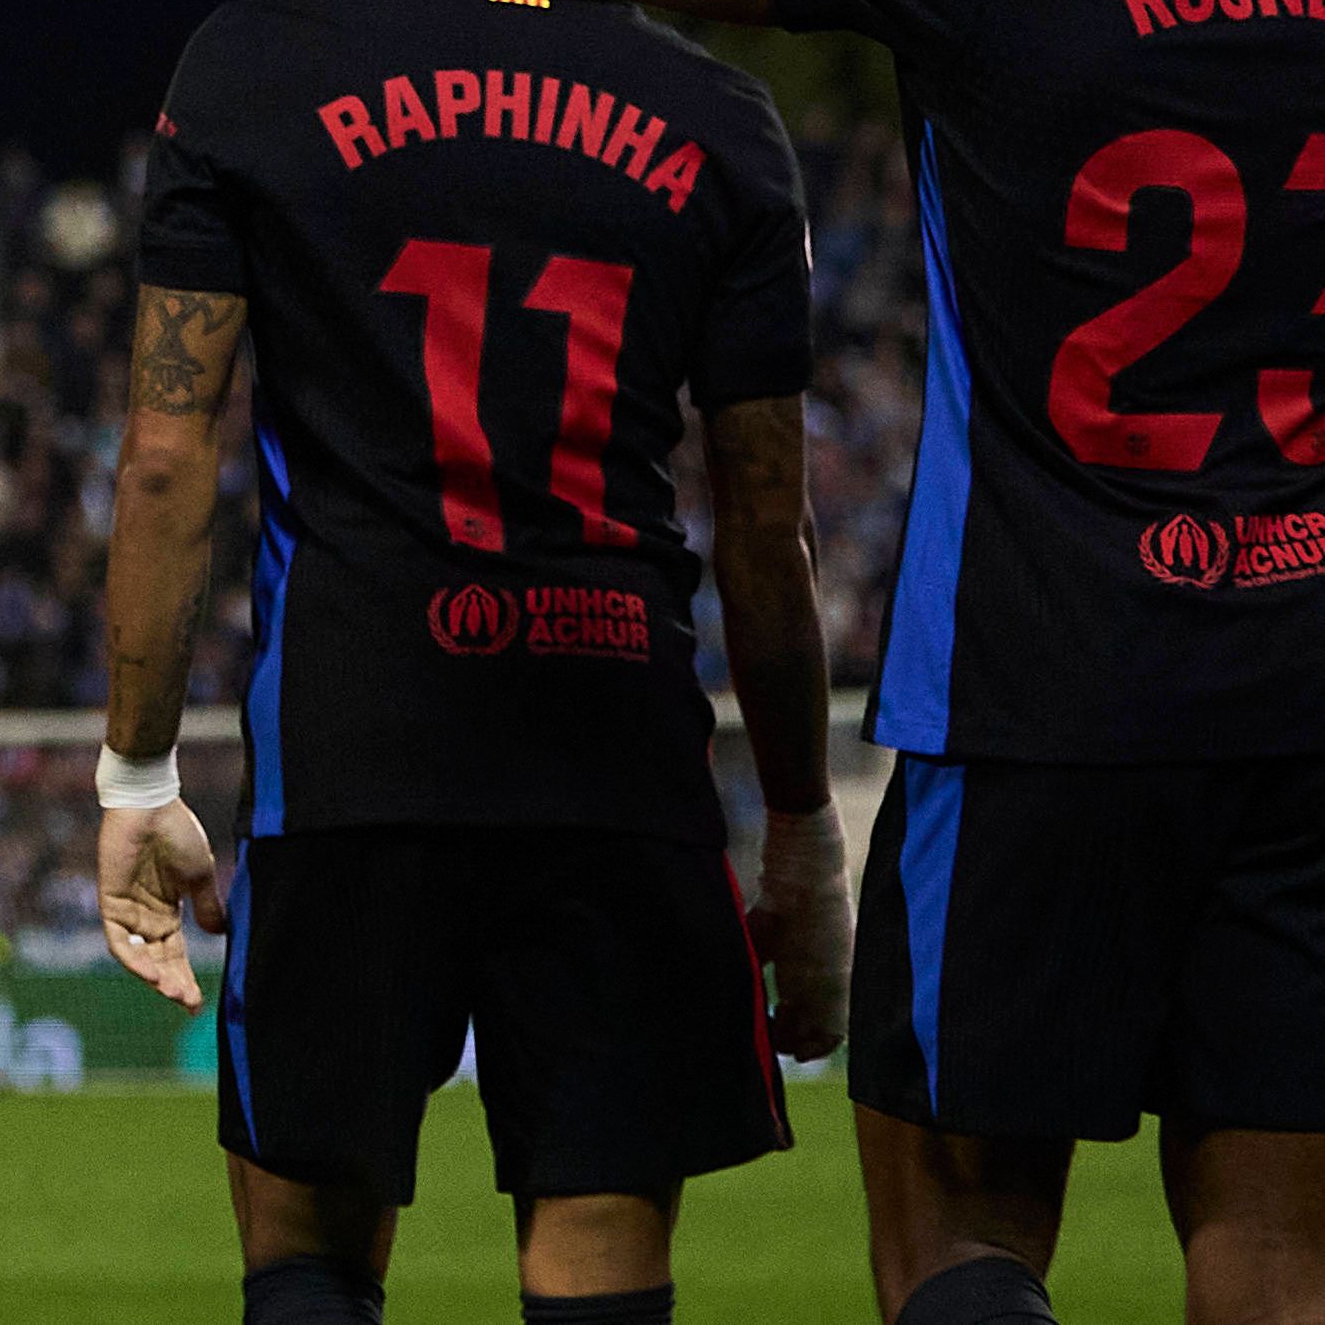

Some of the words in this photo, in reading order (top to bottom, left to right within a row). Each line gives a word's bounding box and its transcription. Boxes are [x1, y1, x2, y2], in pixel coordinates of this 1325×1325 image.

[318, 69, 707, 215] RAPHINHA
[379, 239, 638, 553] 11
[526, 587, 647, 622] UNHCR
[526, 617, 649, 649] ACNUR
